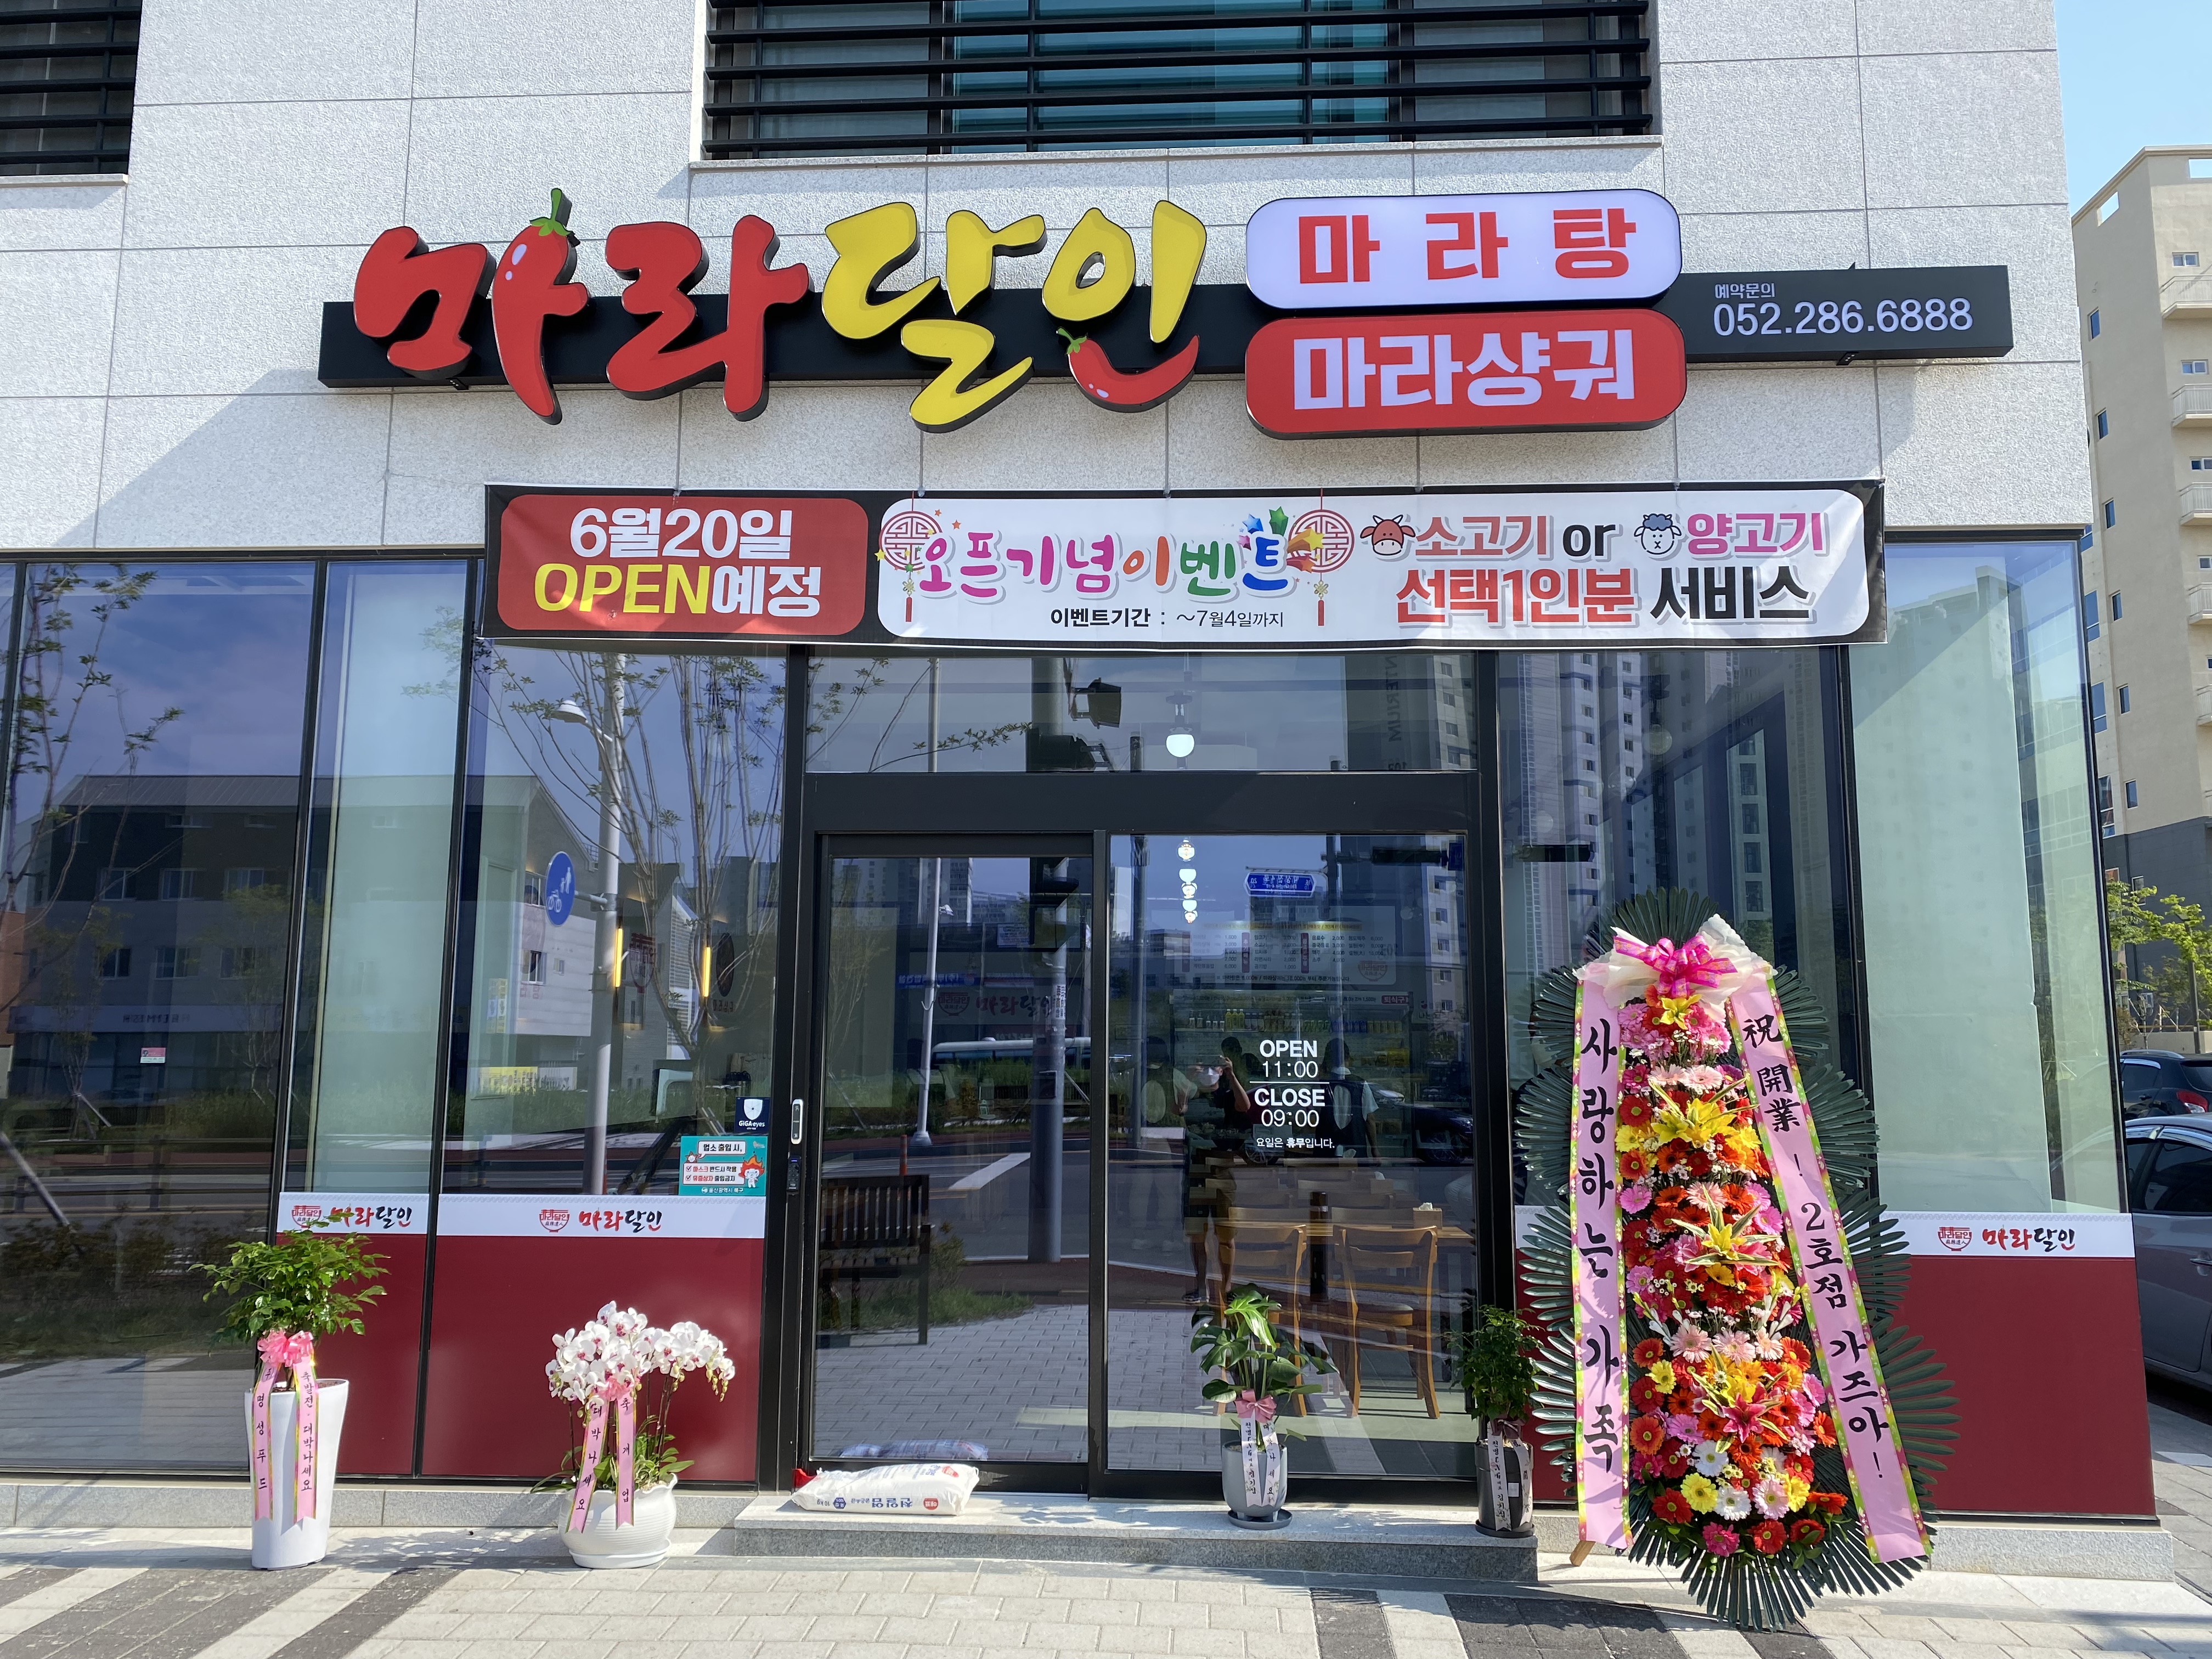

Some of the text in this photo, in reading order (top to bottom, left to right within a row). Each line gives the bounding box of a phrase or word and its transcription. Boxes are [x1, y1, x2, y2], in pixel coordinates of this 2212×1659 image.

[1714, 283, 1775, 299] 예약문의
[1713, 297, 1973, 336] 052.286.6888
[1294, 330, 1635, 410] 마라샹궈
[570, 507, 793, 560] 6월20일
[1415, 512, 1824, 557] 소고기 or 양고기
[534, 562, 821, 618] OPEN예정
[1396, 566, 1810, 623] 선택1인분 서비스
[1051, 608, 1150, 628] 이벤트기간
[1260, 1040, 1317, 1058] OPEN
[1262, 1060, 1318, 1078] 11:00
[1254, 1088, 1325, 1107] CLOSE
[1262, 1109, 1319, 1127] 09:00
[1256, 1137, 1335, 1148] 요일은 휴무입니다.
[578, 1209, 662, 1233] 마라달인
[1578, 1018, 1620, 1474] 사랑하는 가족
[1982, 1227, 2075, 1252] 마라달인
[1801, 1203, 1890, 1479] 2호점 가즈아!
[871, 1497, 913, 1508] 천일염
